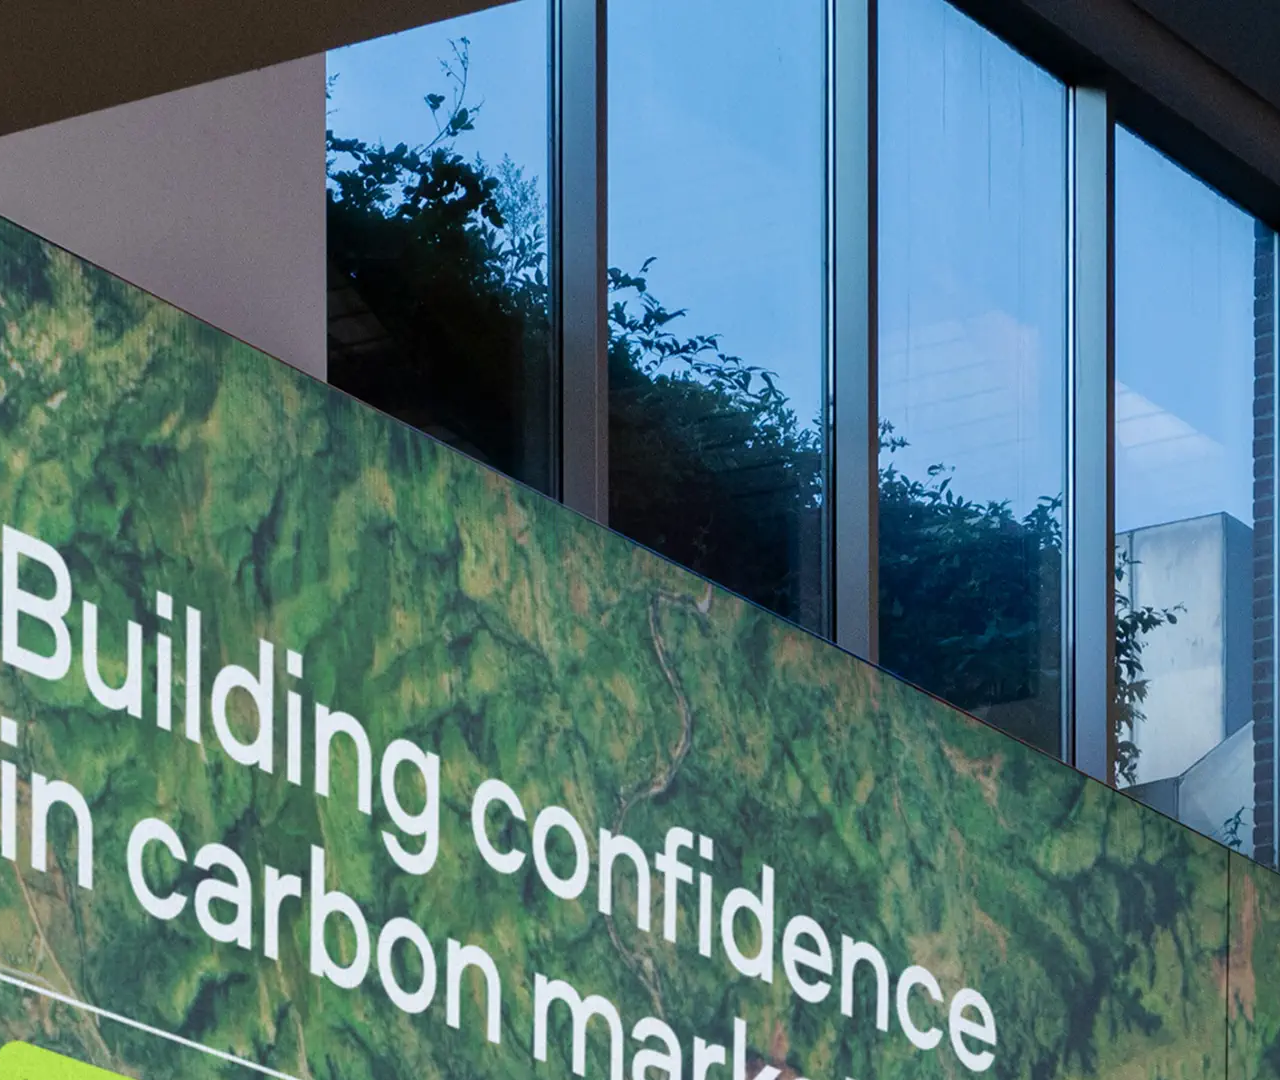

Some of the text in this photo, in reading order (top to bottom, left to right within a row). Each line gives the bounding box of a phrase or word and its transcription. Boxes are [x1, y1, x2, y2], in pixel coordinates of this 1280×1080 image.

[0, 716, 93, 890] in
[127, 816, 501, 1045] carbon
[1, 523, 996, 1073] Building confidence
